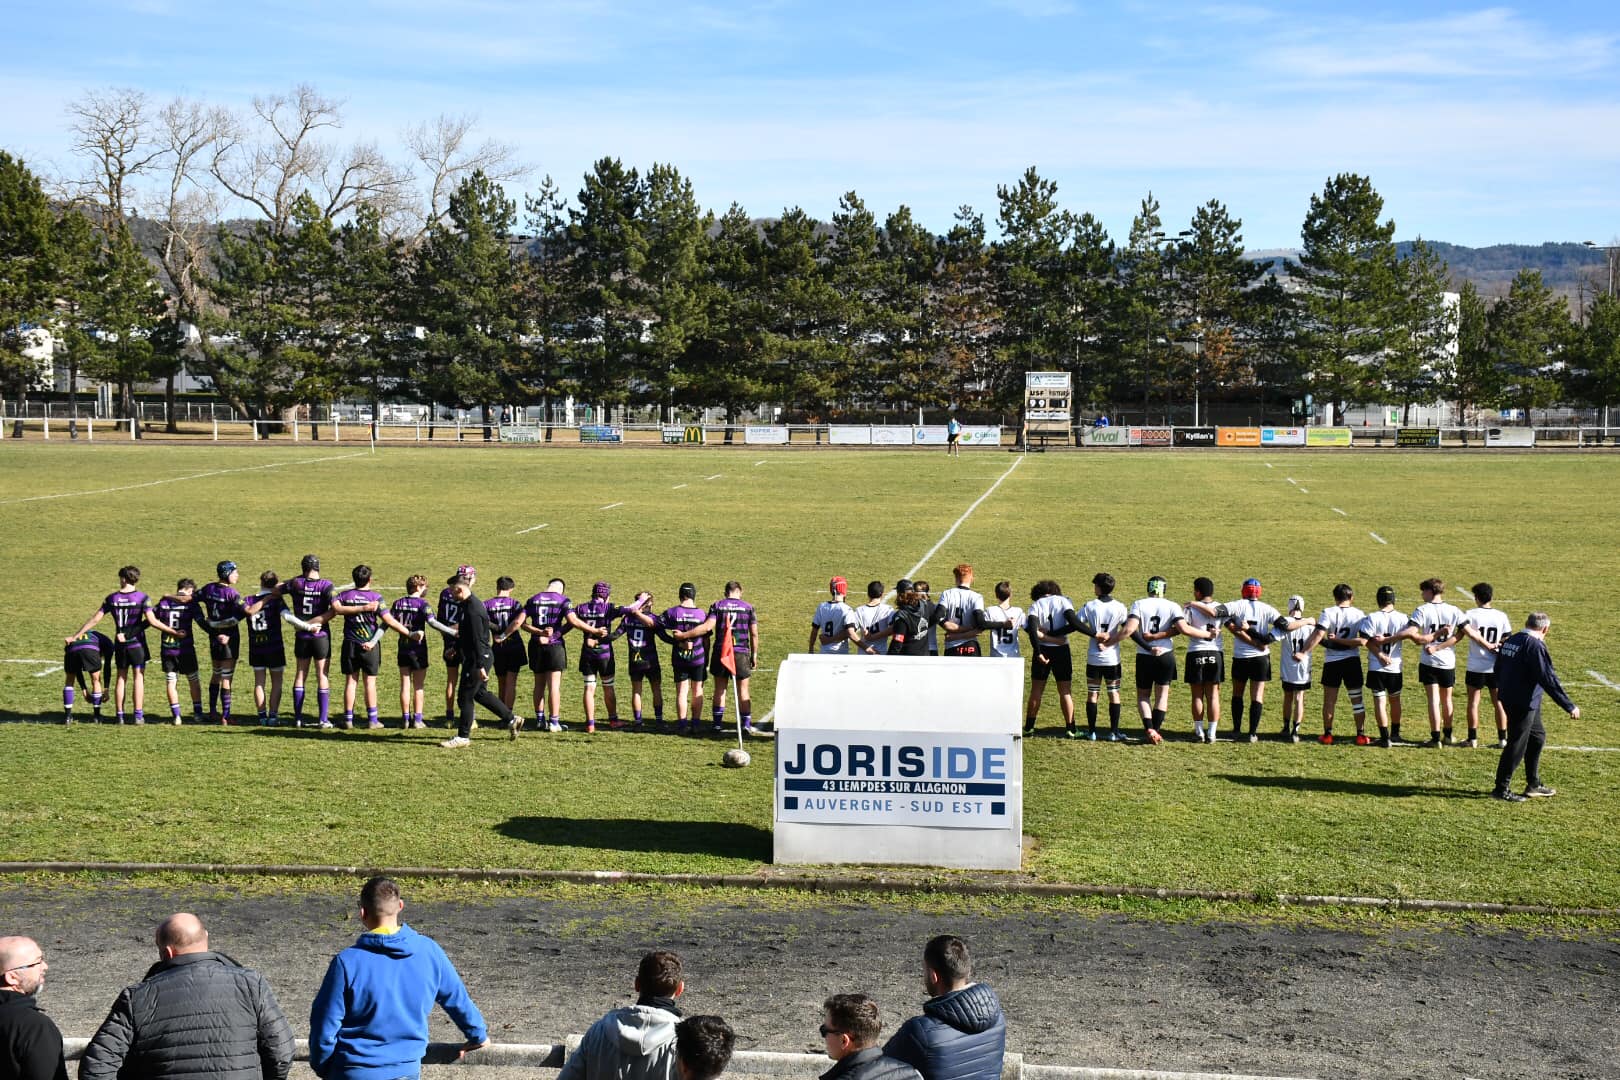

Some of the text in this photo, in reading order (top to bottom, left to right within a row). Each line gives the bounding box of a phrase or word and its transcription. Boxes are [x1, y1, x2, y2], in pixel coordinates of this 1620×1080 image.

[1091, 431, 1119, 442] Vival
[303, 596, 314, 615] 5
[445, 602, 458, 623] 12
[824, 621, 834, 637] 9
[1149, 615, 1161, 633] 3
[633, 629, 644, 647] 9
[1479, 626, 1498, 646] 10
[784, 743, 1006, 779] JORISIDE
[822, 781, 967, 794] 43 LEMPDES SUR ALAGNON
[804, 798, 893, 812] AUVERGNE
[911, 800, 944, 813] SUD
[952, 801, 983, 814] EST
